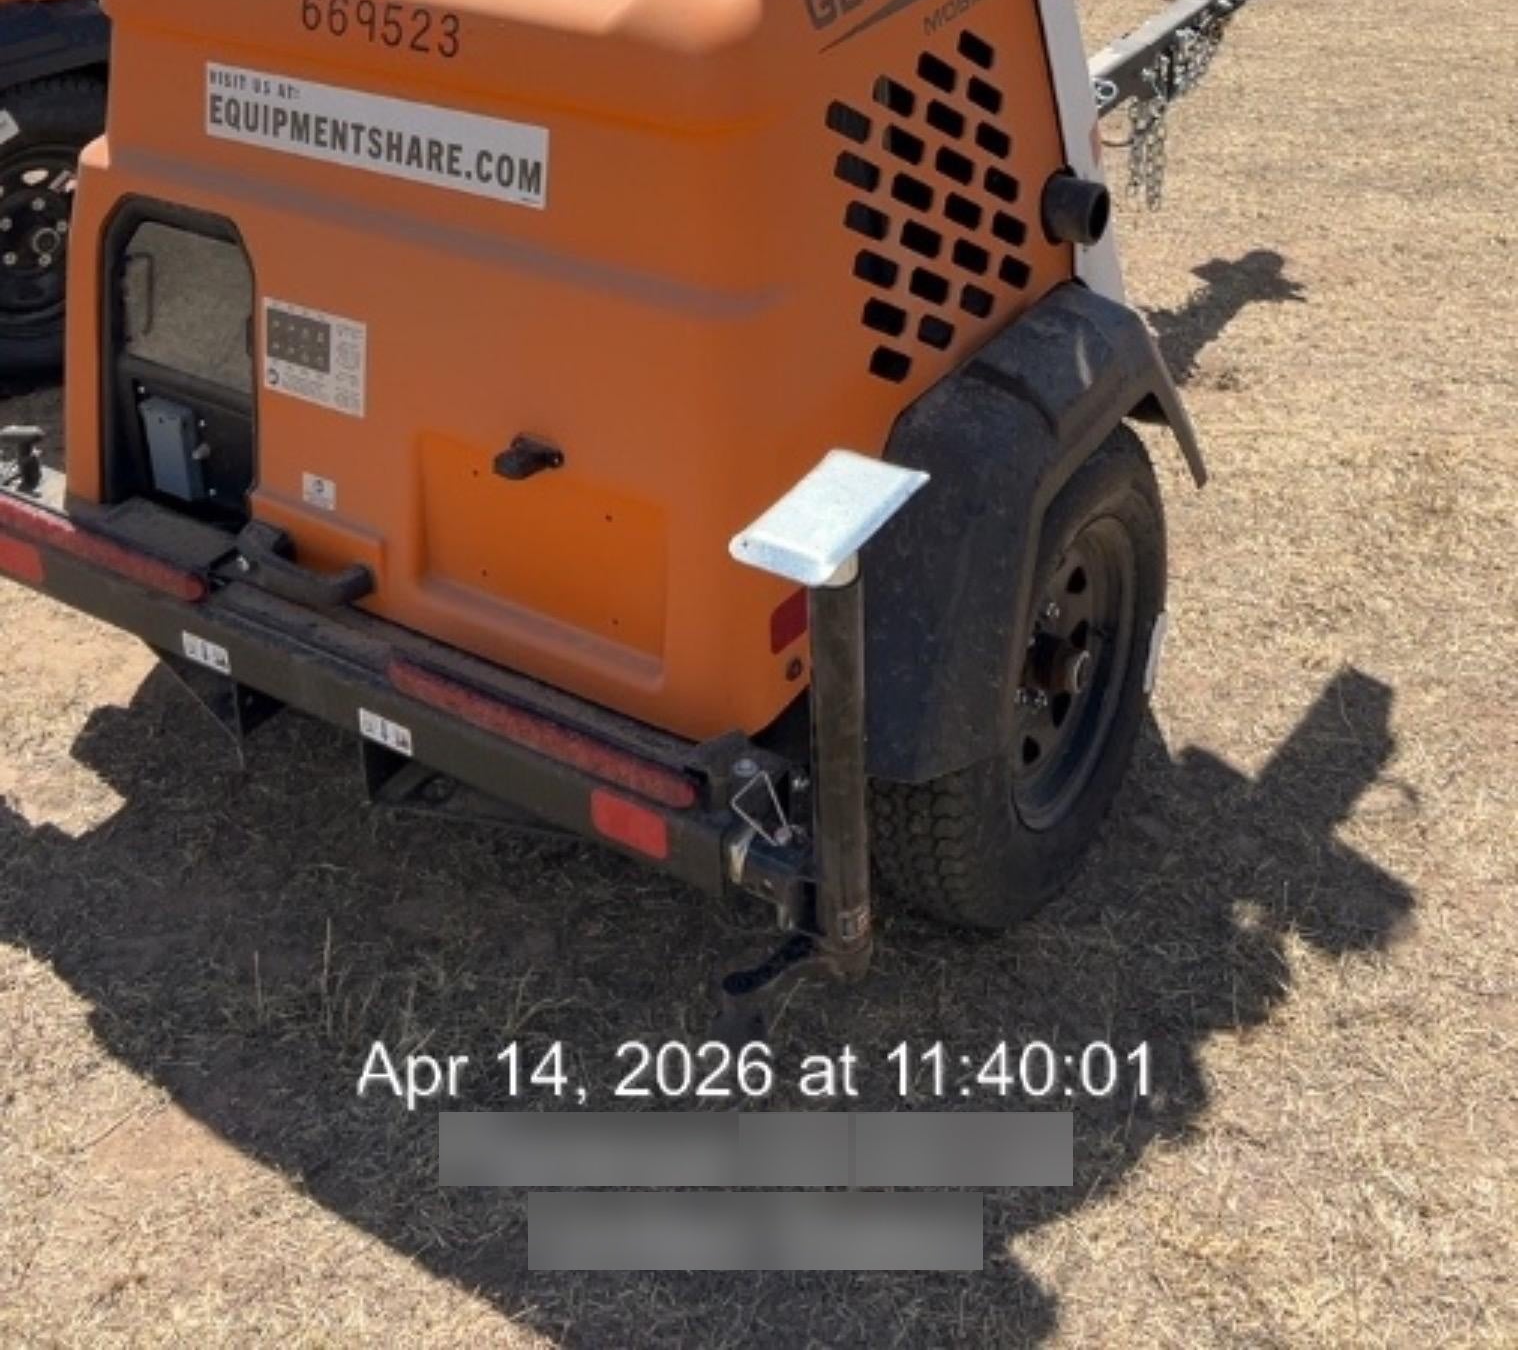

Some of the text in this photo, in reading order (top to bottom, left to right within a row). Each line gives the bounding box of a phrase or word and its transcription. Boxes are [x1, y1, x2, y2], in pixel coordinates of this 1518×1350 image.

[209, 70, 246, 90] VISIT
[253, 77, 271, 96] US
[209, 94, 542, 196] EQUIPMENTSHARE.COM
